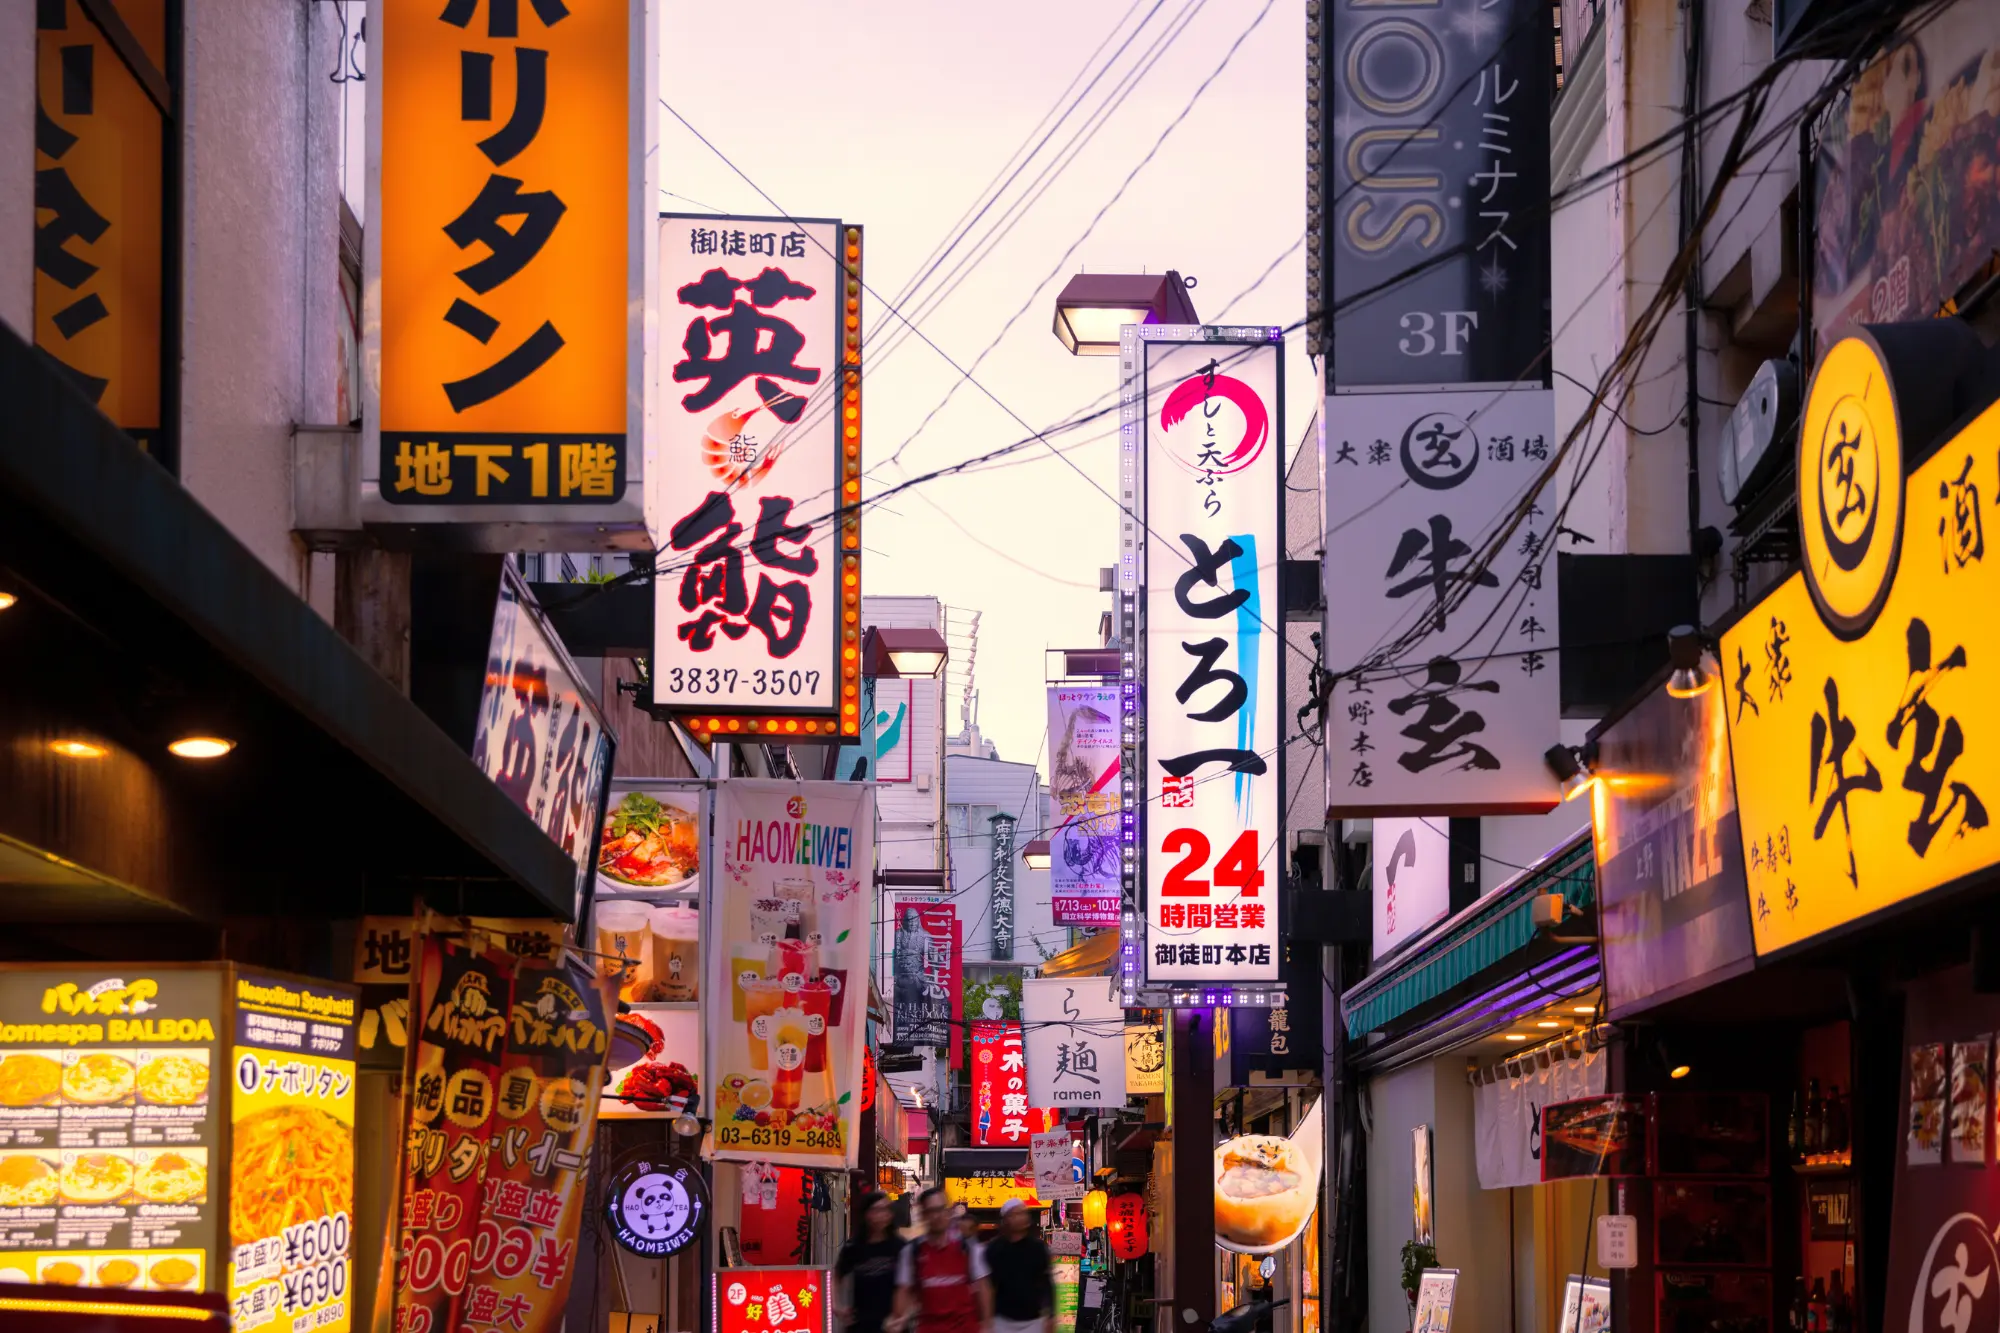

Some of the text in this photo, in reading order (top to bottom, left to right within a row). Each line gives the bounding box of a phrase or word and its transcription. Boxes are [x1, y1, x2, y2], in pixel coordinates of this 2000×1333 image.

[1346, 0, 1447, 252] OUS
[1472, 63, 1519, 251] ルミナス
[440, 0, 570, 414] リタン
[690, 228, 807, 257] 御徒町店
[1398, 310, 1479, 357] 3F
[1195, 357, 1229, 519] すしと天ぷら
[1487, 434, 1550, 463] 酒場
[394, 440, 619, 498] 地下1階
[1384, 513, 1502, 776] 牛玄
[669, 667, 821, 696] 3837-3507
[789, 797, 807, 817] 2F
[737, 820, 852, 869] HAOMEIWEI
[1161, 828, 1265, 897] 24
[1160, 904, 1266, 929] 時間営業
[1155, 943, 1271, 966] 御徒町本店
[238, 980, 300, 1007] Neapolitan
[301, 991, 354, 1016] Spaghetti
[108, 1019, 214, 1042] BALBOA
[264, 1062, 351, 1097] ナポリタン
[1000, 1026, 1029, 1142] 二木の菓子
[1053, 1089, 1101, 1101] ramen
[236, 1216, 346, 1272] 並盛り ¥600
[619, 1228, 694, 1252] HAOMEIWEI
[234, 1284, 280, 1319] 大盛り
[283, 1260, 345, 1312] ¥690
[730, 1289, 744, 1299] 2F
[317, 1302, 344, 1324] ¥890
